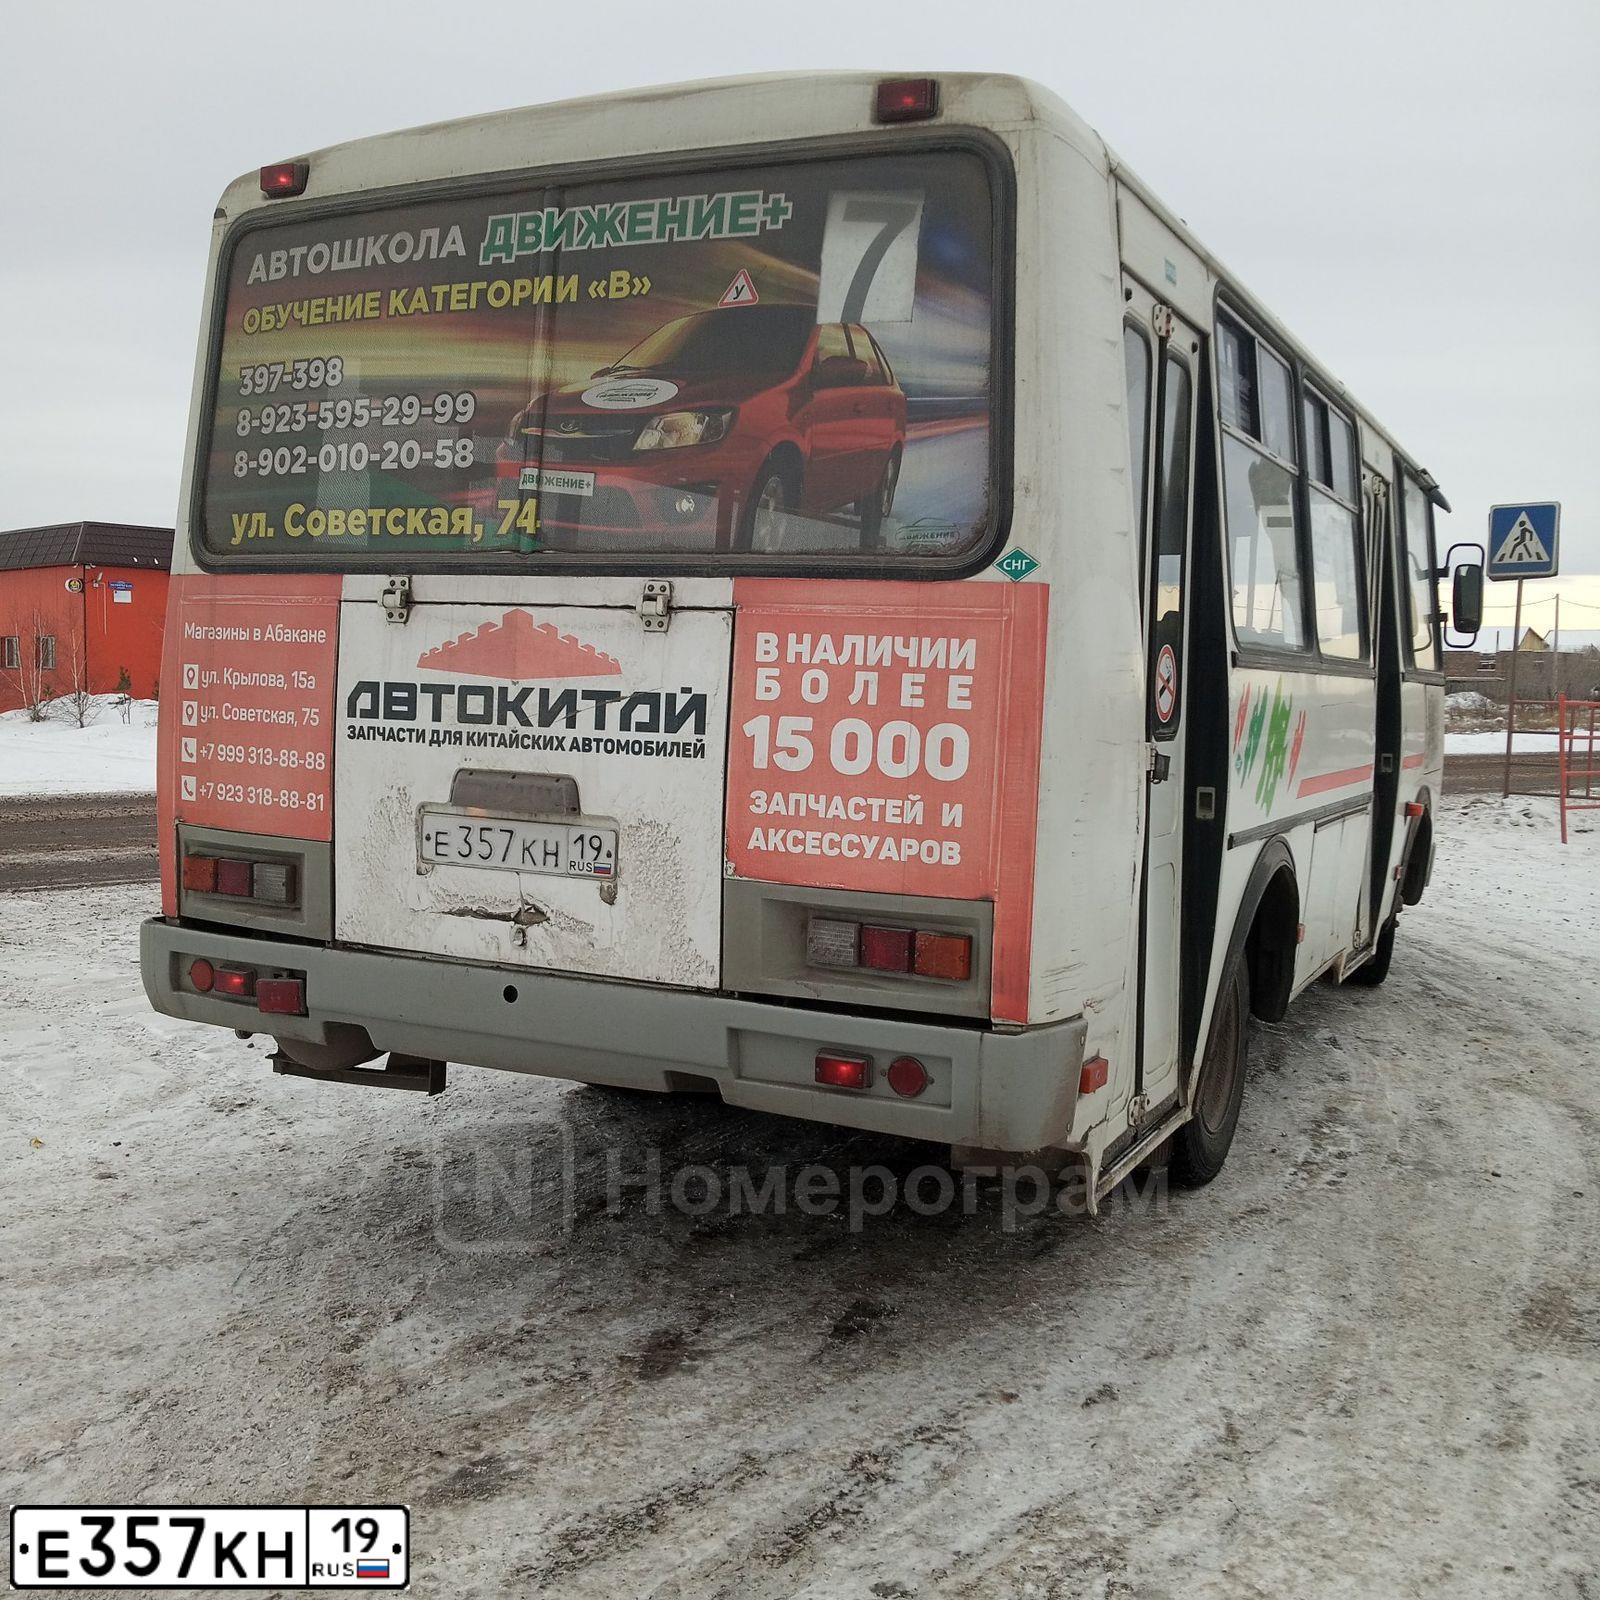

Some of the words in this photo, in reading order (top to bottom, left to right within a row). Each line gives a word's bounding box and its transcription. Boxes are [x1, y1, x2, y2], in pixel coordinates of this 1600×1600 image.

[246, 225, 467, 284] АВТОШКОЛА
[478, 189, 794, 266] ДВИЖЕНИЕ+
[841, 200, 916, 323] 7
[242, 292, 381, 335] ОБУЧЕНИЕ
[387, 273, 579, 317] КАТЕГОРИИ
[588, 270, 651, 299] «В»
[239, 356, 344, 396] 397-398
[236, 392, 476, 436] 8-923-595-29-99
[233, 438, 475, 478] 8-902-010-20-58
[230, 510, 274, 545] ул.
[283, 502, 484, 542] Советская,
[496, 498, 538, 536] 74
[1002, 558, 1031, 571] СНГ
[184, 622, 249, 641] Магазины
[253, 629, 261, 641] в
[264, 624, 327, 644] Абакане
[755, 632, 779, 664] В
[786, 632, 977, 670] НАЛИЧИИ
[201, 668, 220, 686] ул.
[223, 667, 288, 690] Крылова,
[291, 672, 316, 690] 15а
[200, 705, 219, 724] ул.
[221, 703, 298, 727] Советская,
[302, 708, 321, 728] 75
[347, 680, 707, 736] АВТОКИТАЙ
[199, 743, 216, 761] +7
[217, 744, 245, 763] 999
[247, 746, 326, 771] 313-88-88
[347, 724, 426, 745] ЗАПЧАСТИ
[428, 728, 463, 748] ДЛЯ
[466, 728, 566, 753] КИТАЙСКИХ
[569, 737, 706, 760] АВТОМОБИЛЕЙ
[199, 782, 215, 799] +7
[216, 784, 244, 803] 923
[246, 786, 325, 811] 318-88-81
[749, 790, 924, 825] ЗАПЧАСТЕЙ
[941, 803, 963, 828] И
[573, 833, 603, 861] 19
[747, 827, 962, 866] АКСЕССУАРОВ
[569, 861, 592, 873] RUS
